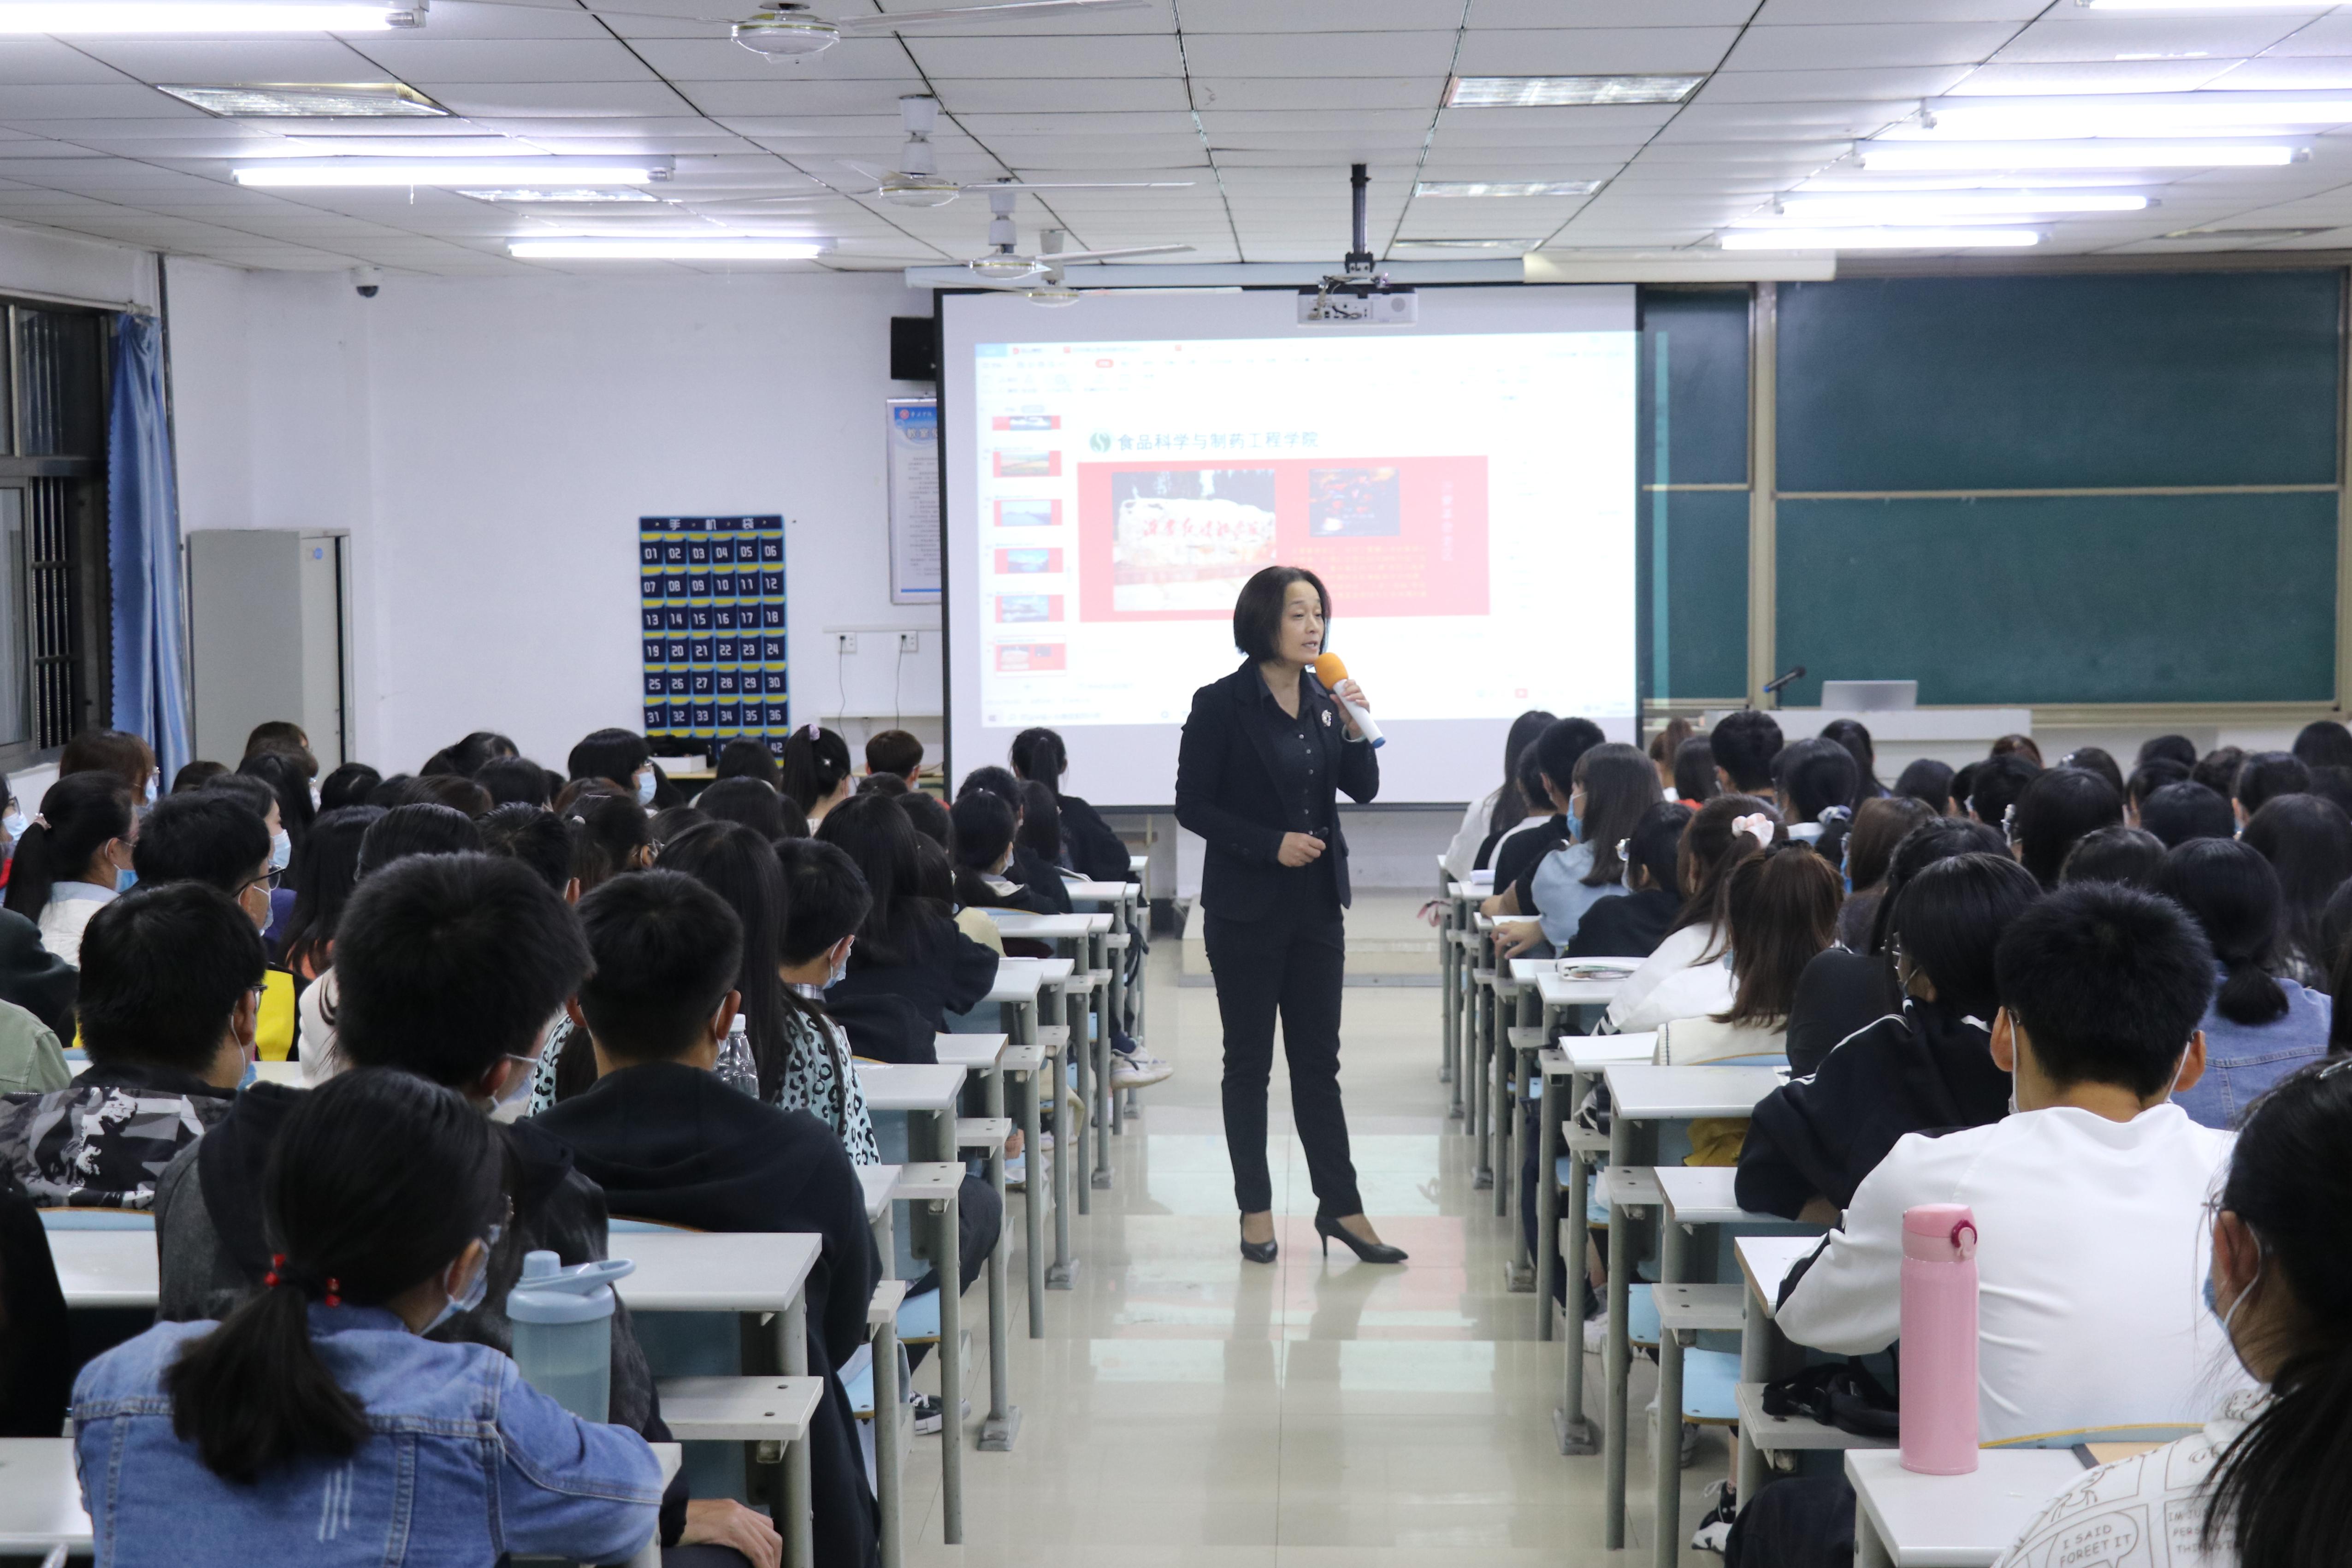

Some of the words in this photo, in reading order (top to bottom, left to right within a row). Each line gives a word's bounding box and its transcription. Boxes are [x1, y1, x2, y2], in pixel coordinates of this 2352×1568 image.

[1117, 431, 1319, 450] 食品科学与制药工程学院
[644, 548, 657, 559] 01
[669, 548, 681, 559] 02
[693, 548, 705, 559] 03
[716, 547, 728, 558] 04
[740, 546, 753, 557] 05
[765, 545, 777, 556] 06
[644, 581, 656, 592] 07
[668, 580, 680, 592] 08
[692, 580, 704, 591] 09
[717, 580, 729, 591] 10
[741, 579, 753, 589] 11
[765, 578, 777, 589] 12
[647, 615, 658, 625] 13
[671, 613, 682, 624] 14
[694, 614, 706, 624] 15
[717, 613, 729, 624] 16
[742, 612, 753, 623] 17
[767, 611, 779, 622] 18
[647, 645, 659, 657] 19
[672, 645, 684, 657] 20
[696, 645, 708, 657] 21
[720, 645, 732, 656] 22
[743, 644, 755, 656] 23
[767, 644, 779, 655] 24
[649, 679, 661, 690] 25
[672, 678, 684, 689] 26
[696, 677, 708, 688] 27
[721, 678, 733, 688] 28
[745, 677, 756, 688] 29
[768, 677, 780, 687] 30
[647, 711, 659, 722] 31
[674, 711, 685, 722] 32
[697, 710, 709, 721] 33
[721, 711, 732, 721] 34
[746, 710, 757, 721] 35
[769, 710, 781, 720] 36
[771, 742, 783, 753] 42
[2063, 1539, 2069, 1550] I
[2075, 1524, 2112, 1544] SAID
[2115, 1533, 2133, 1548] IT
